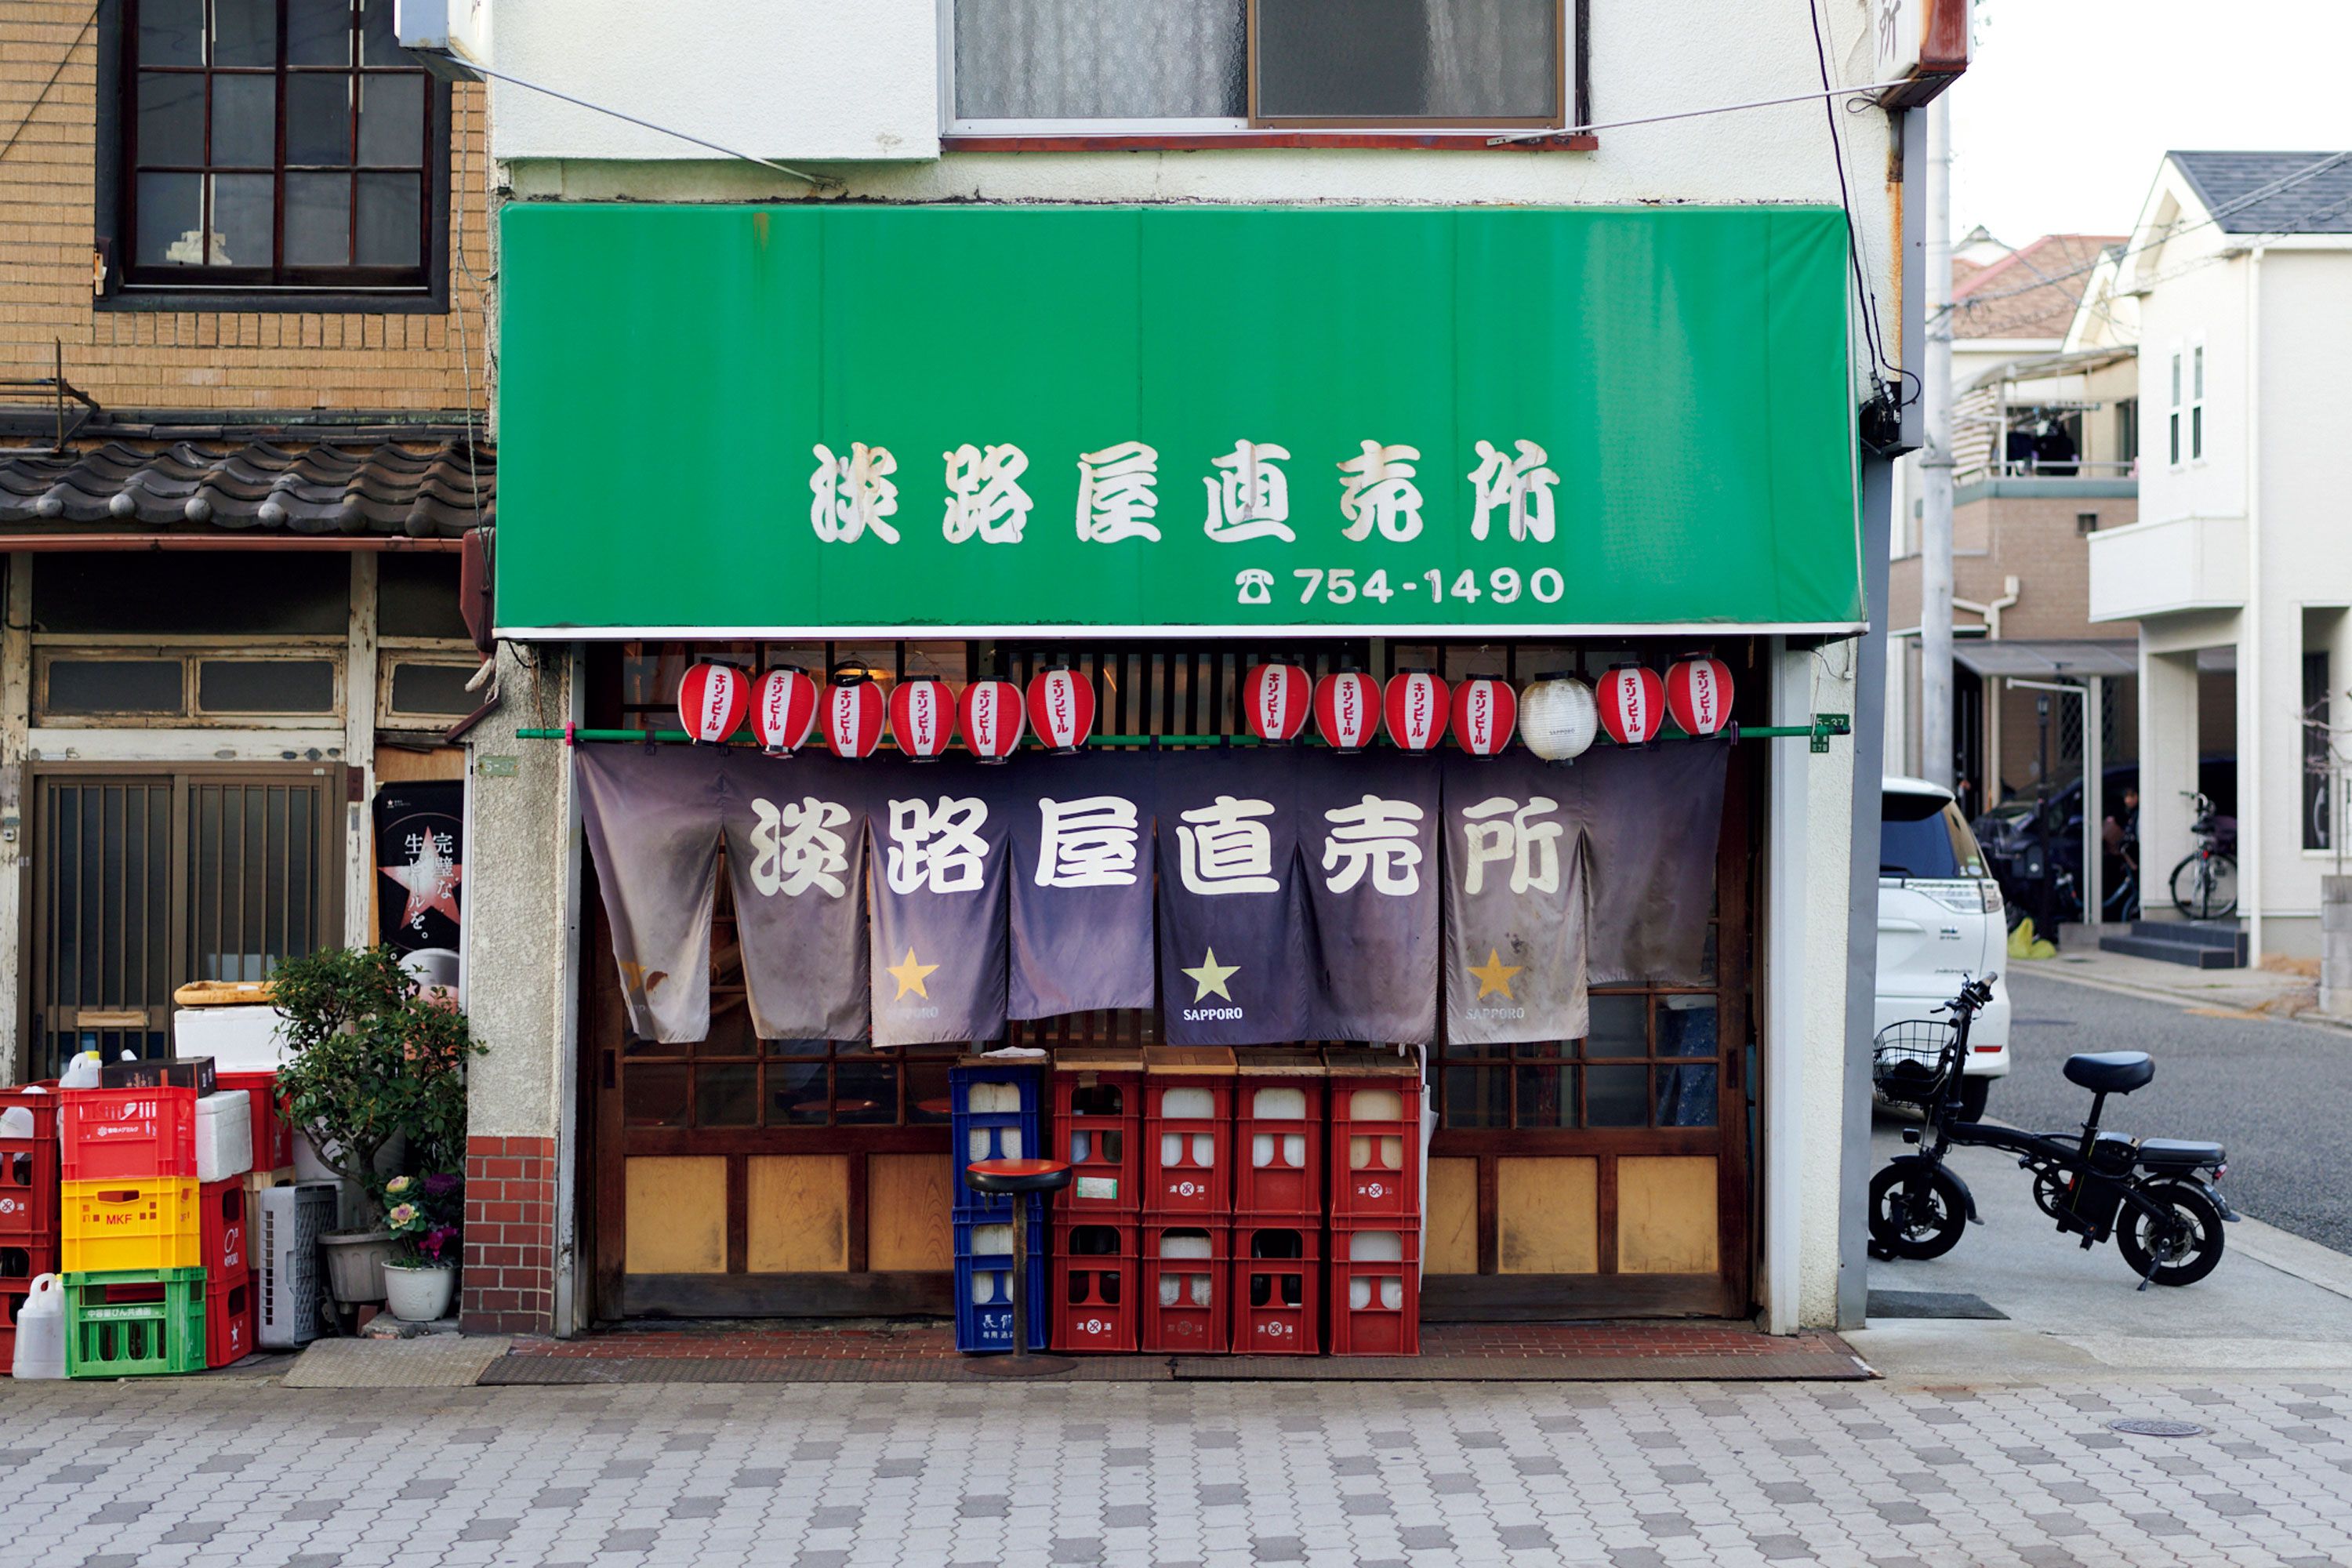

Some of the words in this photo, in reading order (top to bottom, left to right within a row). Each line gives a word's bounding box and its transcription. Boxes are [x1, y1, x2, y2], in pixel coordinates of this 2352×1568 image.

[810, 439, 1559, 544] 淡路屋直売所
[1294, 568, 1564, 604] 754-1490
[706, 674, 727, 731] キリンビール
[768, 676, 785, 731] キリンビール
[840, 690, 853, 745] キリンビール
[916, 690, 931, 745] キリンビール
[978, 690, 992, 745] キリンビール
[1052, 679, 1069, 734] キリンビール
[1265, 673, 1280, 729] キリンビール
[1341, 681, 1356, 735] キリンビール
[1411, 683, 1426, 737] キリンビール
[1474, 690, 1486, 745] キリンビール
[1624, 677, 1641, 732] キリンビール
[1696, 670, 1711, 724] キリンビール
[433, 833, 454, 898] 完璧な
[750, 795, 1563, 898] 淡路屋直売所
[1183, 1007, 1243, 1020] SAPPORO
[1466, 1007, 1525, 1019] SAPPORO
[107, 1214, 132, 1225] MKF
